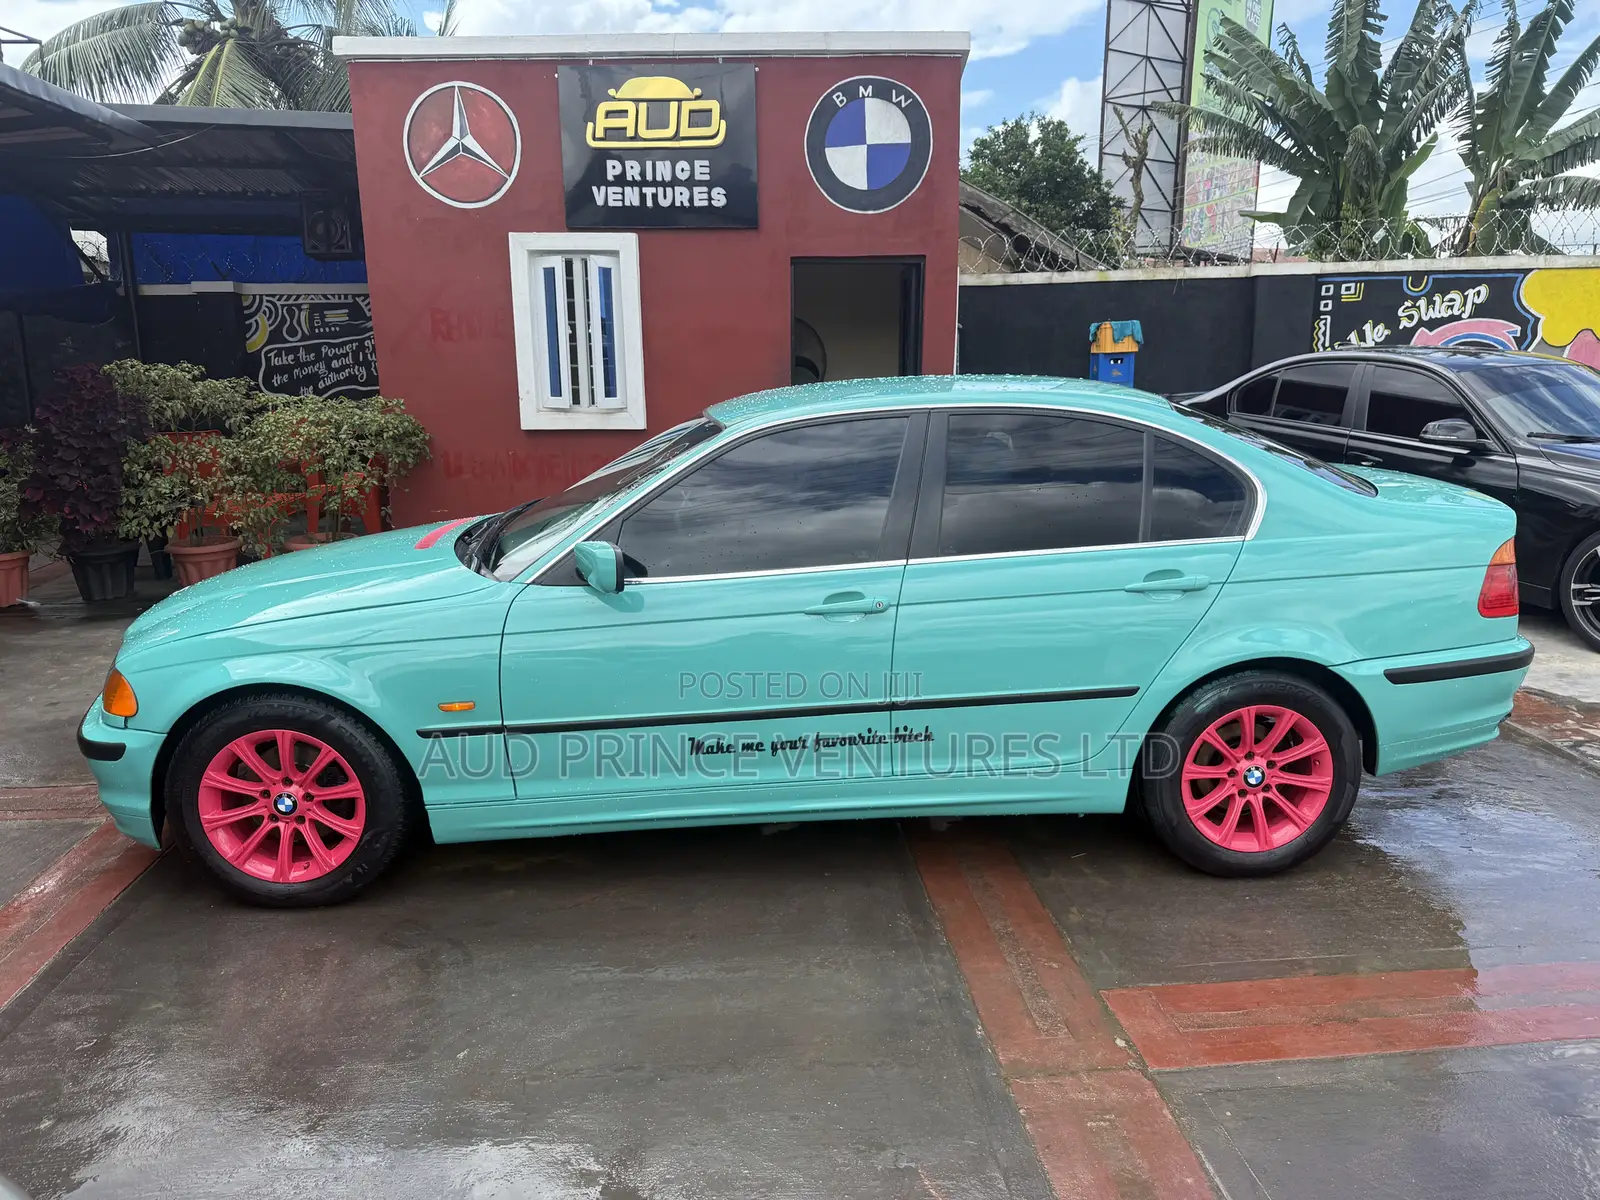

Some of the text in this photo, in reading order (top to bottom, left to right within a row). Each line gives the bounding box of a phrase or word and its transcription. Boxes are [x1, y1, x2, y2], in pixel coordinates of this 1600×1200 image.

[832, 85, 912, 108] BMW
[595, 100, 720, 140] AUD
[606, 159, 711, 182] PRINCE
[592, 186, 727, 208] VENTURES
[267, 350, 296, 366] Take
[297, 346, 316, 362] the
[272, 373, 289, 387] the
[331, 352, 354, 369] and
[318, 364, 367, 389] authority
[688, 725, 935, 757] Make me your favourite bitch
